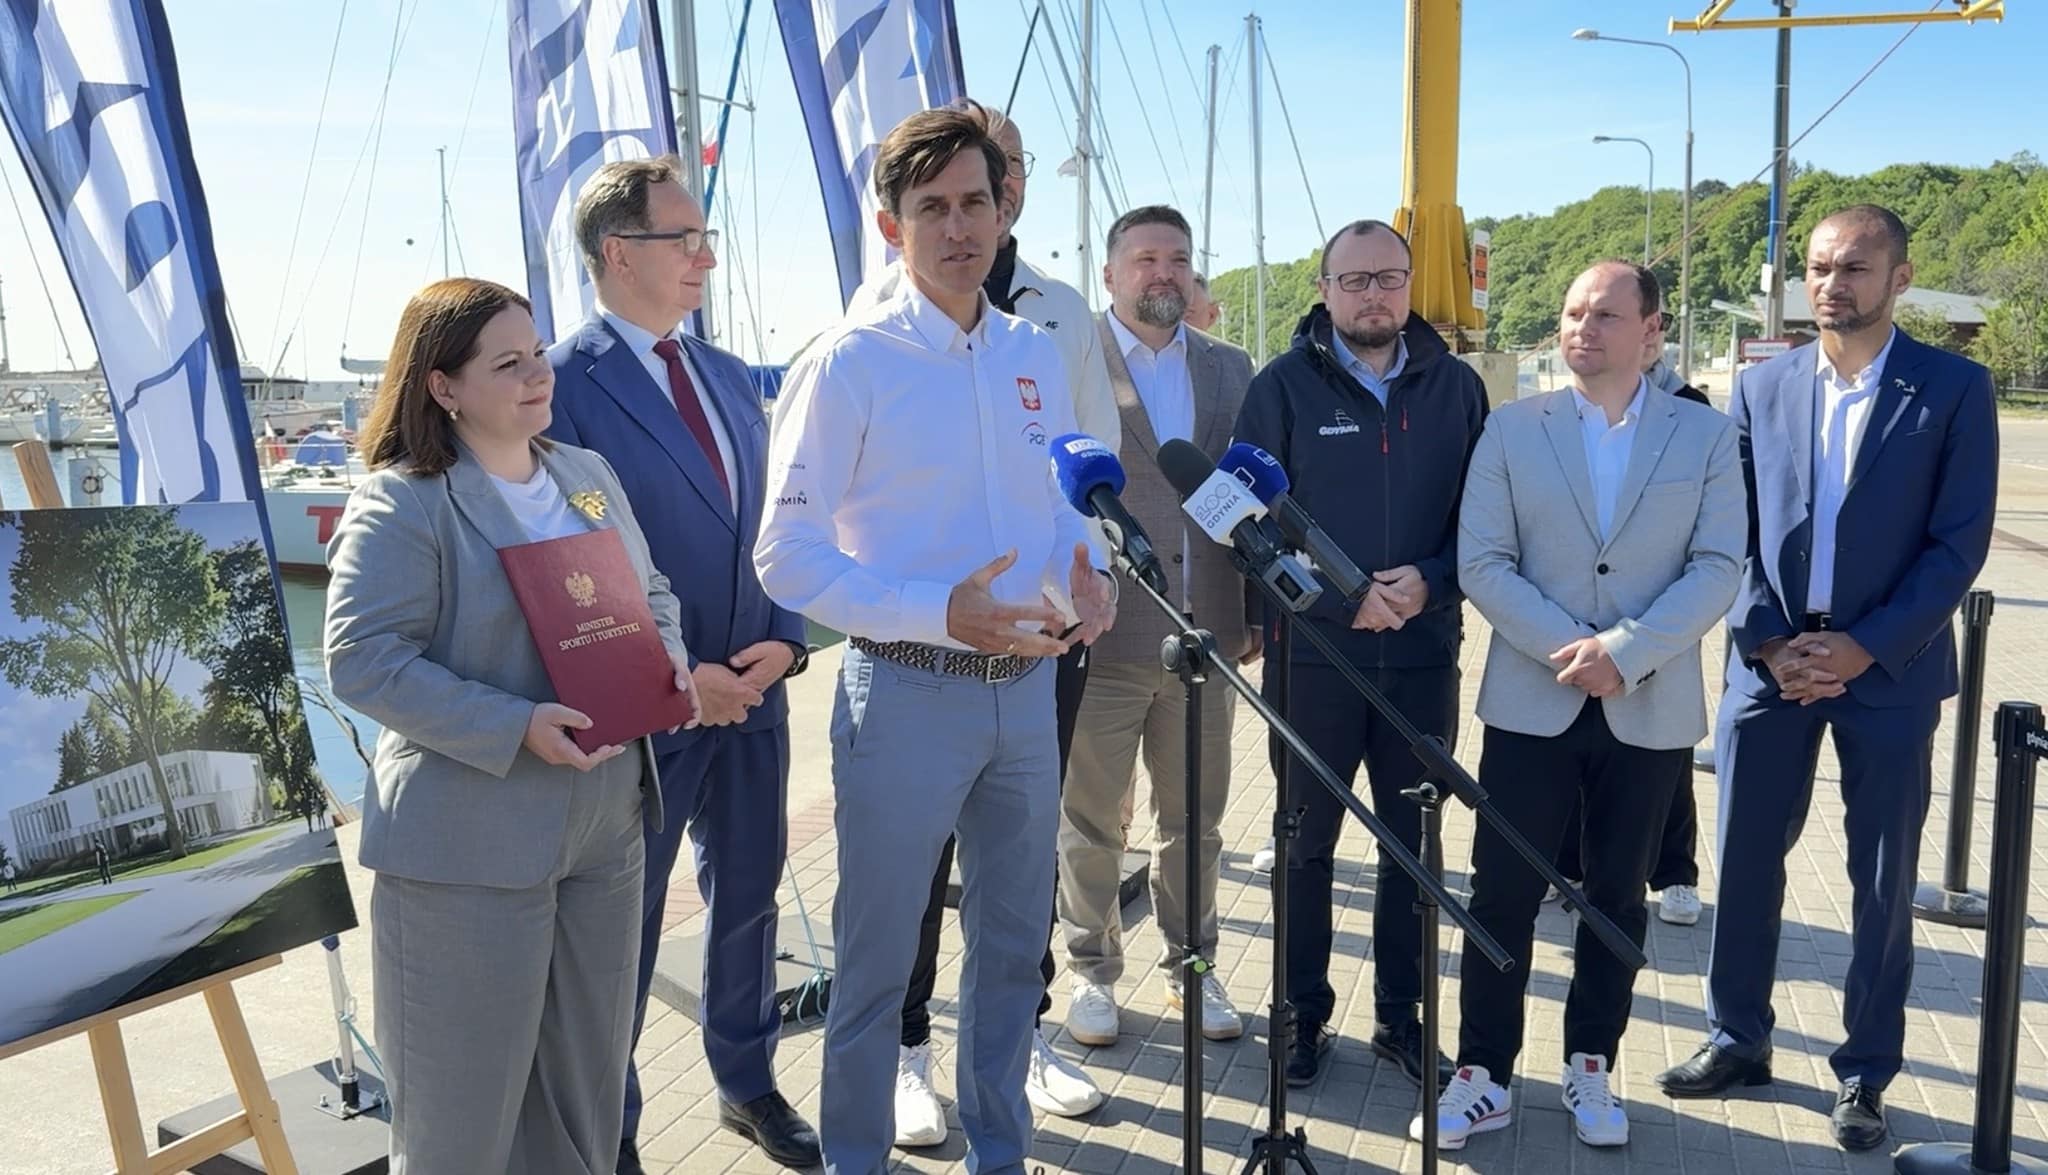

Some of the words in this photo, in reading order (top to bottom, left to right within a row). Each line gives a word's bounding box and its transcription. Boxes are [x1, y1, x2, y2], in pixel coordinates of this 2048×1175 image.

[774, 497, 807, 506] RMIN
[1206, 494, 1241, 529] GDYNIA
[559, 634, 593, 651] SPORTU
[597, 622, 641, 641] TURYSTYKI
[575, 616, 616, 634] MINISTER
